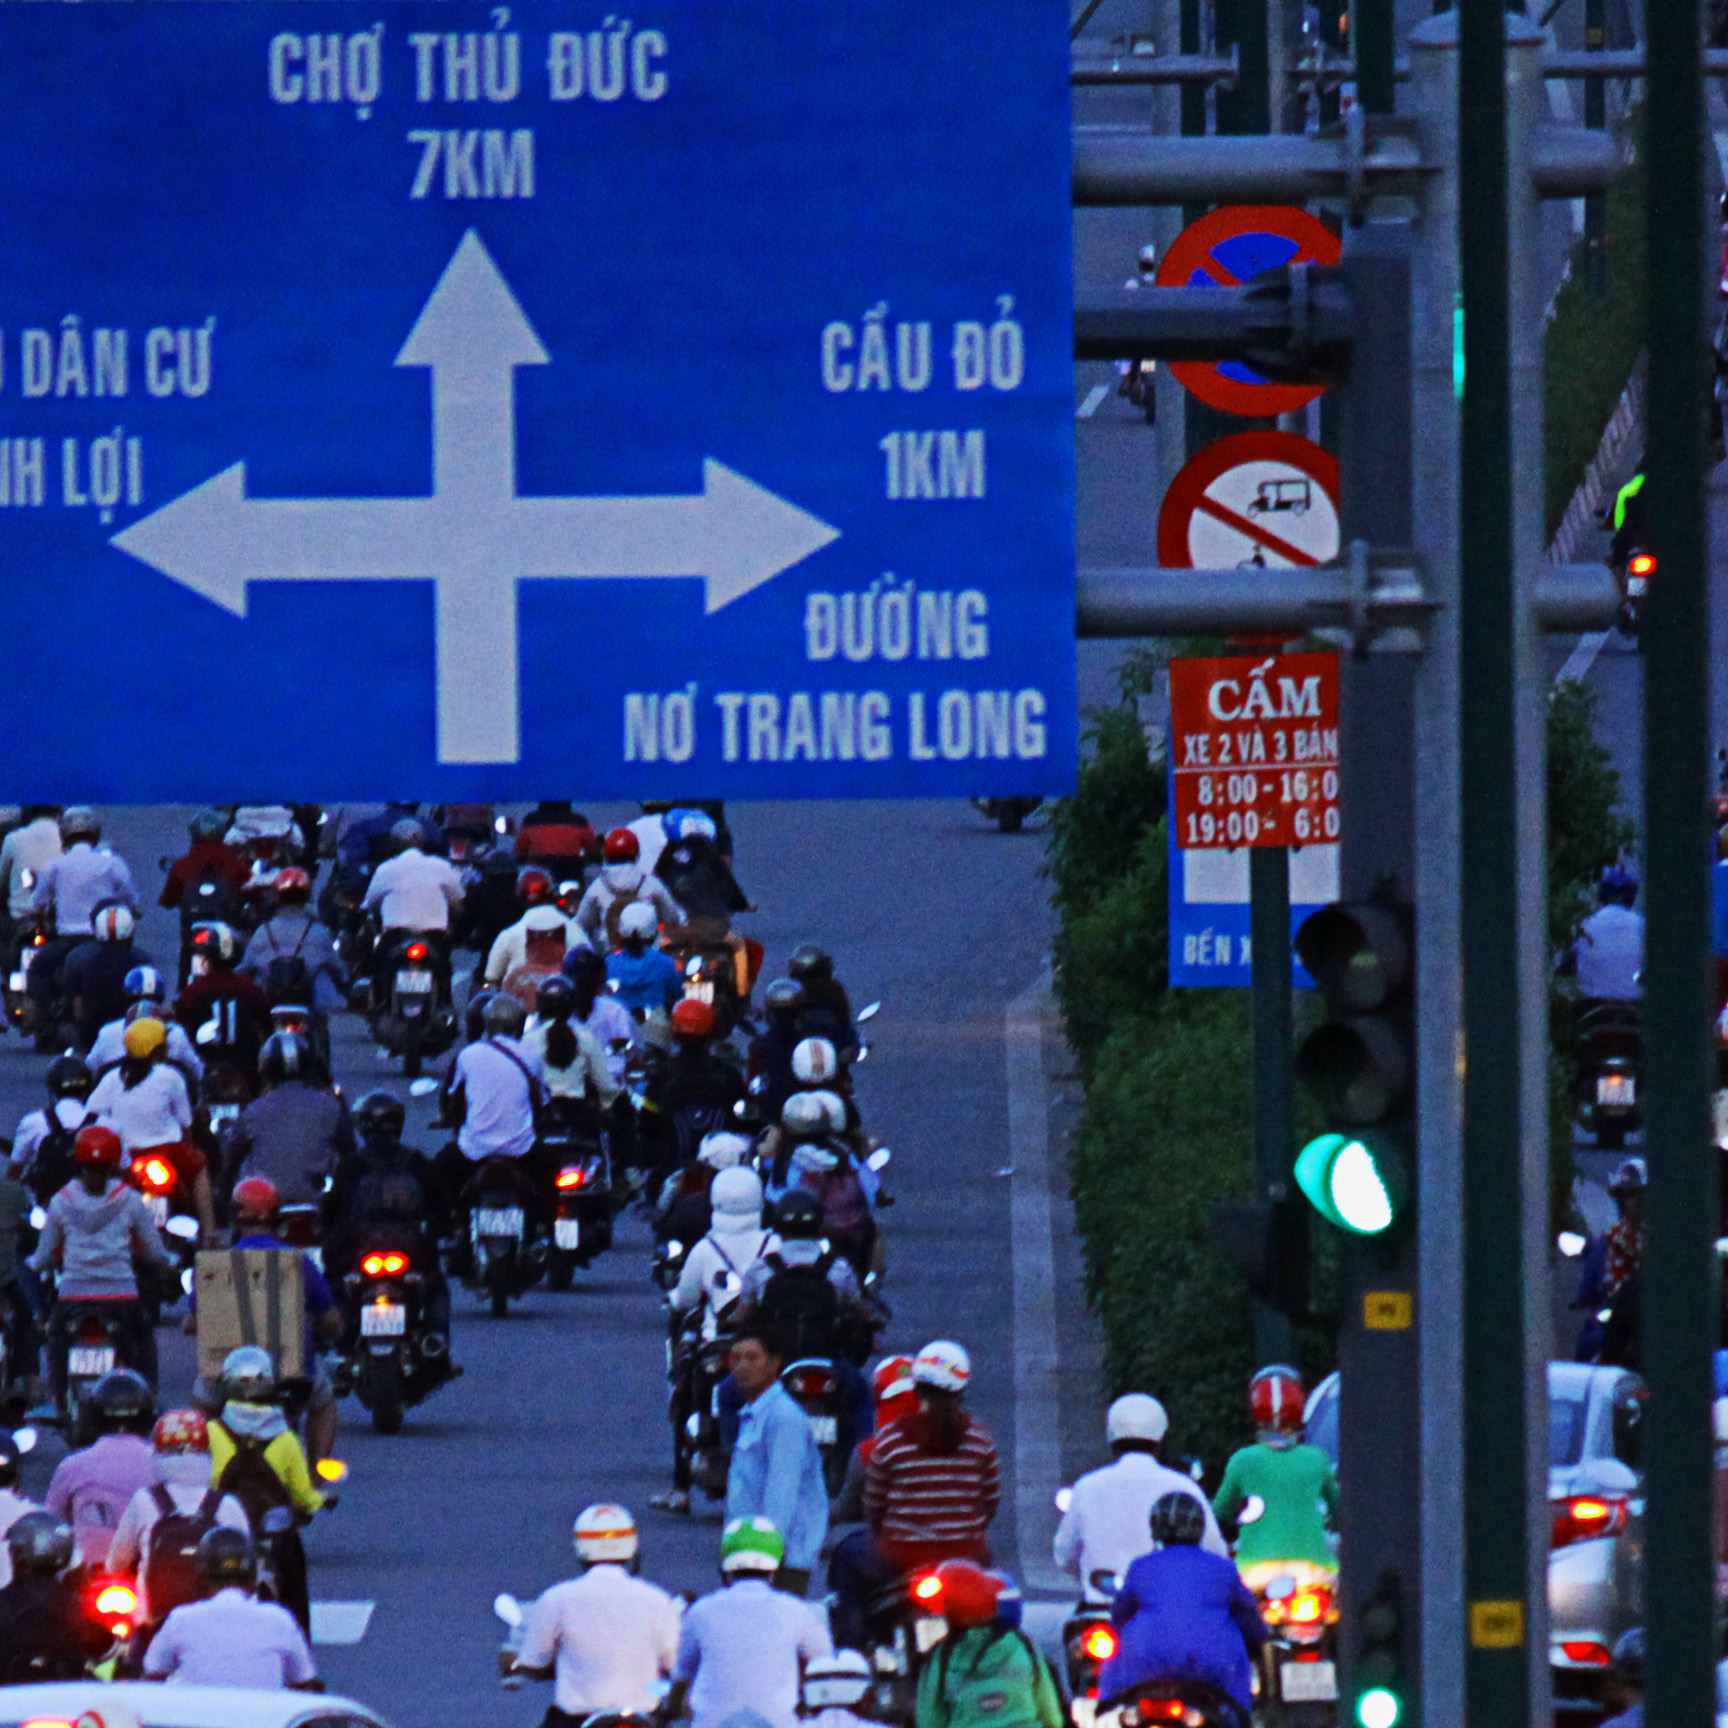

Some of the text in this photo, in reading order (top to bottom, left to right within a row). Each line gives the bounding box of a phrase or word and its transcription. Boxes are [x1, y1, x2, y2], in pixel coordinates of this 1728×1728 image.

[270, 7, 667, 120] CHỢ THỦ ĐỨC
[407, 129, 534, 198] 7KM
[22, 315, 127, 397] DÂN
[146, 316, 215, 397] CƯ
[952, 295, 1023, 390] ĐỎ
[63, 427, 146, 528] LỢI
[880, 430, 985, 498] 1KM
[804, 573, 988, 661] ĐƯỜNG
[1208, 658, 1321, 721] CẤM
[715, 691, 891, 761] TRANG
[910, 688, 1045, 759] LONG
[1185, 734, 1210, 765] XE
[1219, 733, 1231, 764] 2
[1238, 724, 1266, 763] VÀ
[1274, 729, 1288, 763] 3
[1198, 773, 1258, 805] 8:00
[1188, 810, 1260, 843] 19:00
[1183, 926, 1231, 966] BẾN
